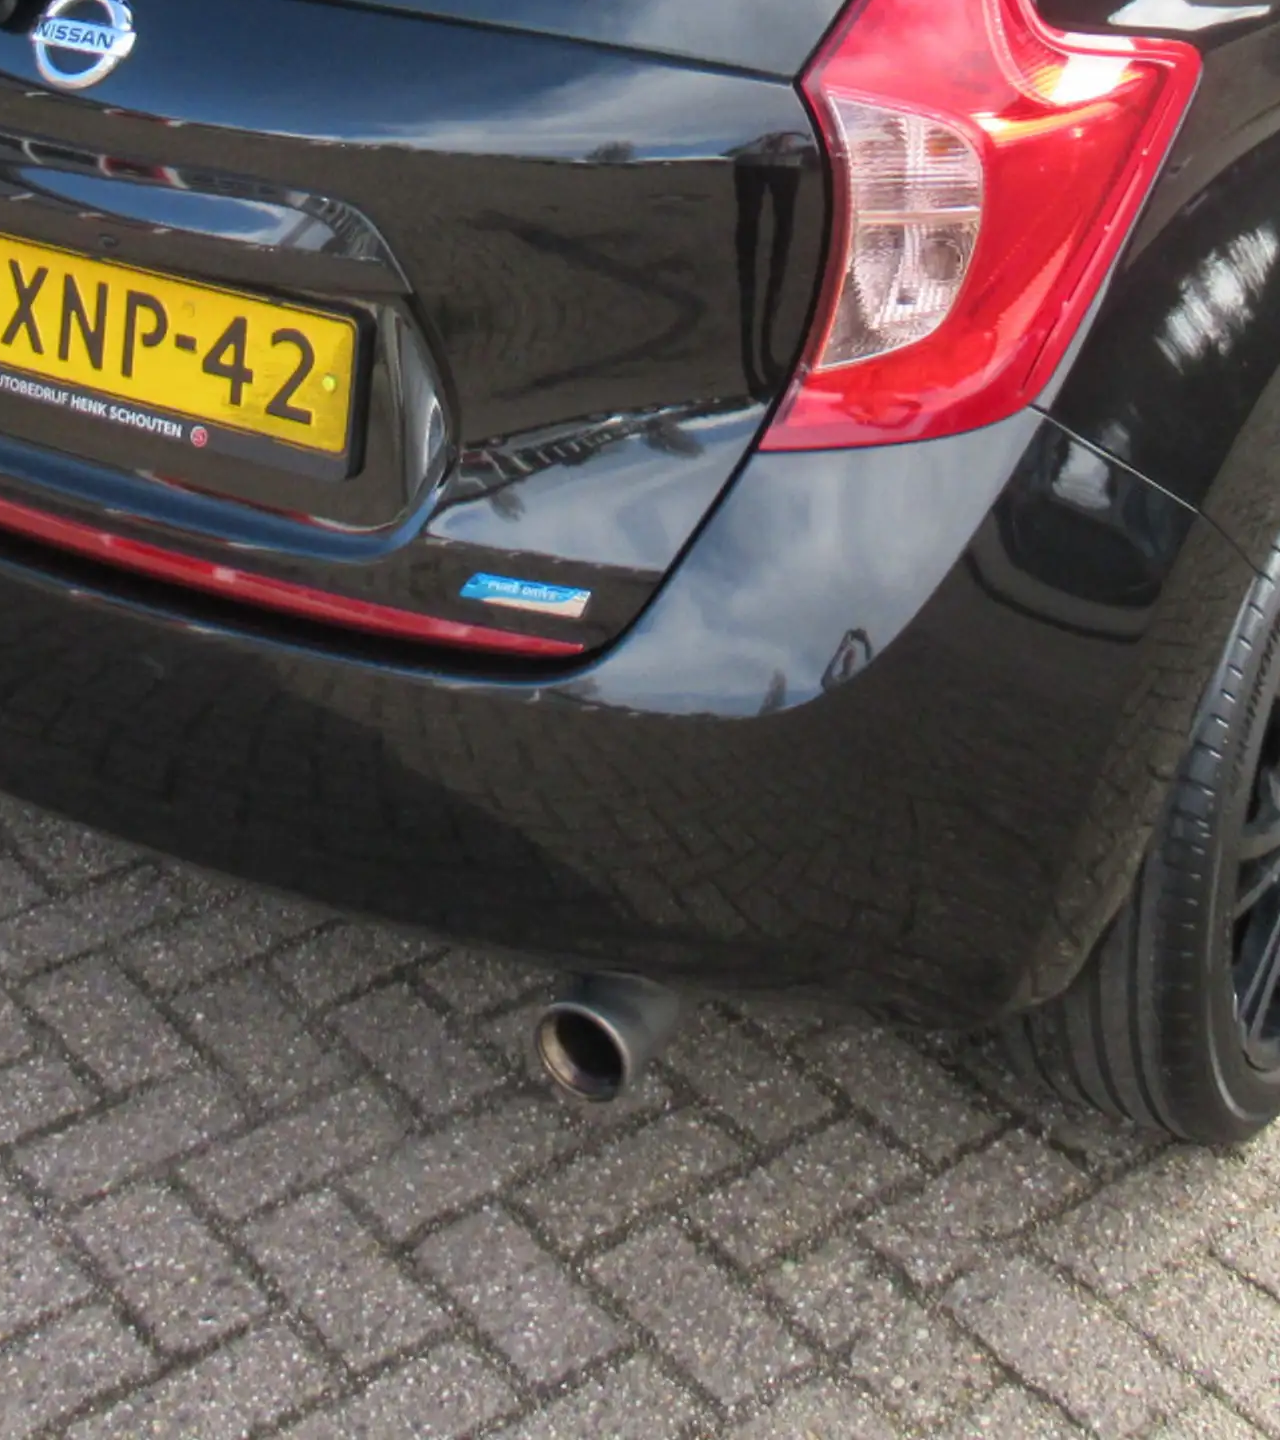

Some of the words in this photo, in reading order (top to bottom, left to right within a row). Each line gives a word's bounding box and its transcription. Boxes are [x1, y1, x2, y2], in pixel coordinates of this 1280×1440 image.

[38, 22, 114, 49] NISSAN
[70, 393, 108, 418] HENK
[109, 406, 182, 438] SCHOUTEN
